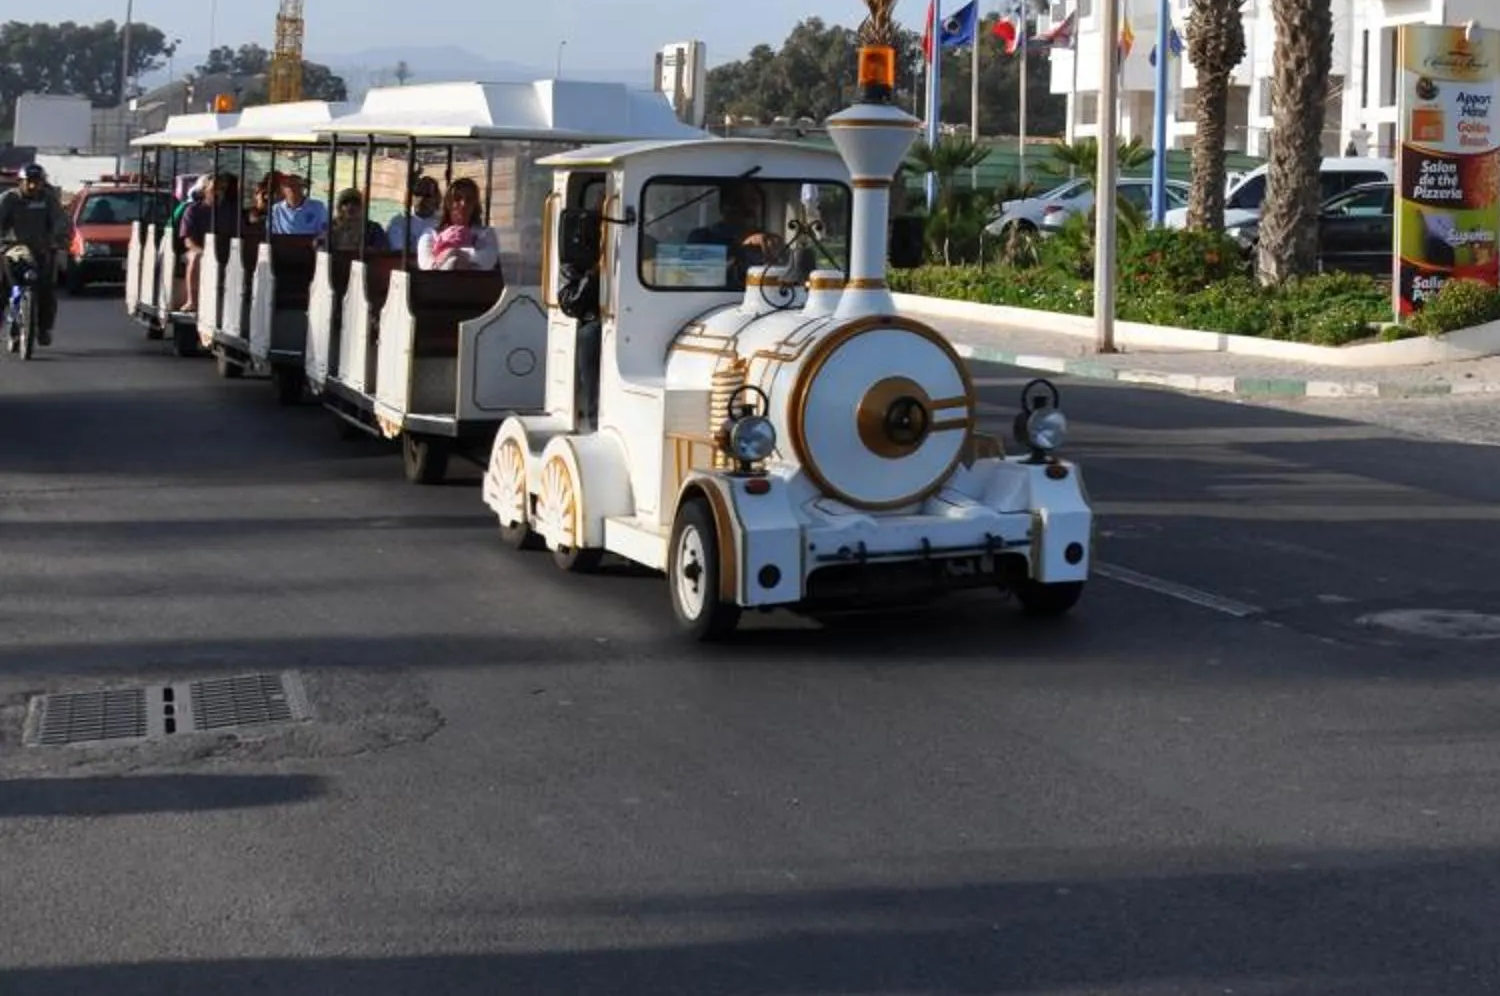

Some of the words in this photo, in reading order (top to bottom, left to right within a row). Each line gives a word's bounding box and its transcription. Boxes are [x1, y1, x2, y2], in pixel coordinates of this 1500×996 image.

[1420, 159, 1457, 173] Salon
[1419, 173, 1436, 186] de
[1413, 185, 1464, 199] Pizzeria
